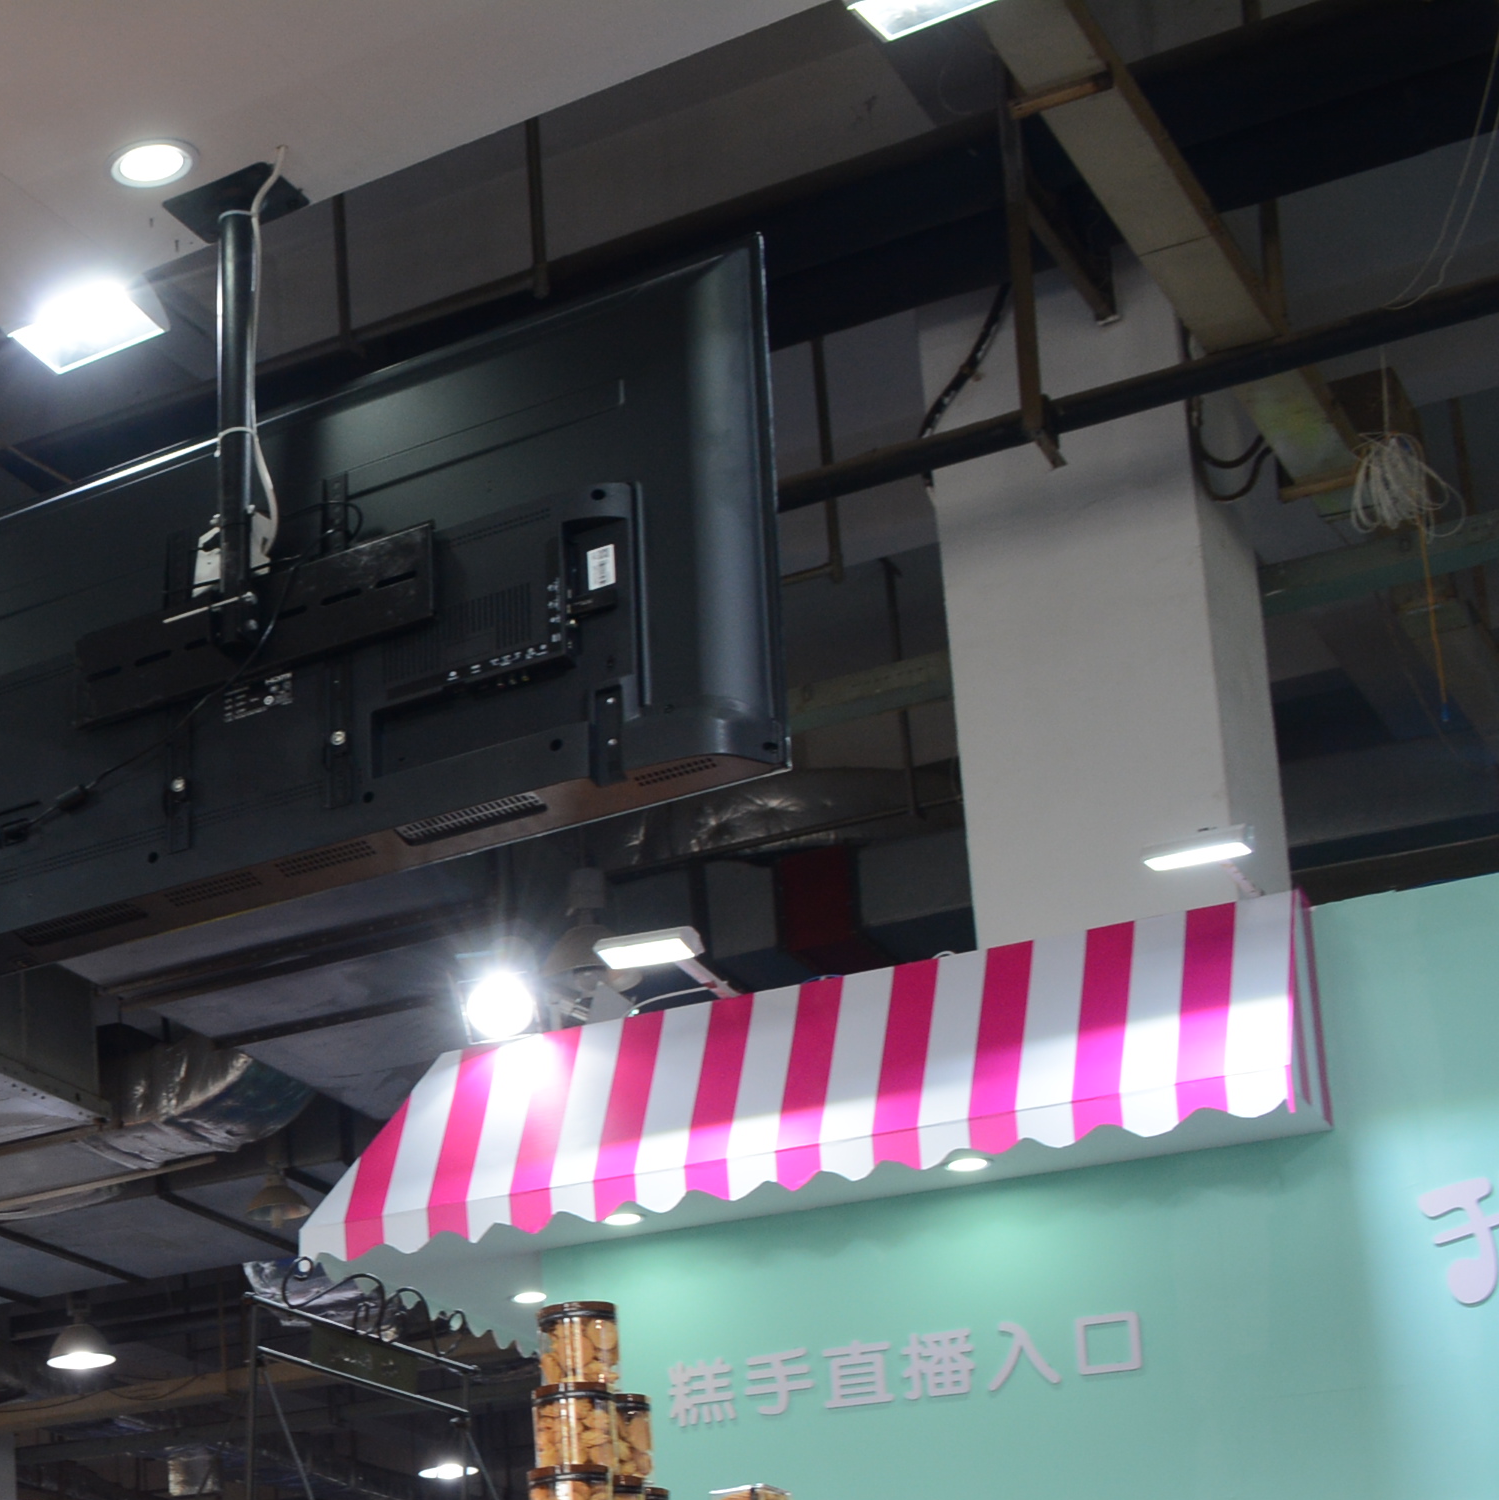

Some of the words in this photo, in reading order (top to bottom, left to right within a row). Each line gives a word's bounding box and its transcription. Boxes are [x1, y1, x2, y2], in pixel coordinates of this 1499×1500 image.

[668, 1310, 1142, 1428] 糕手直播入口
